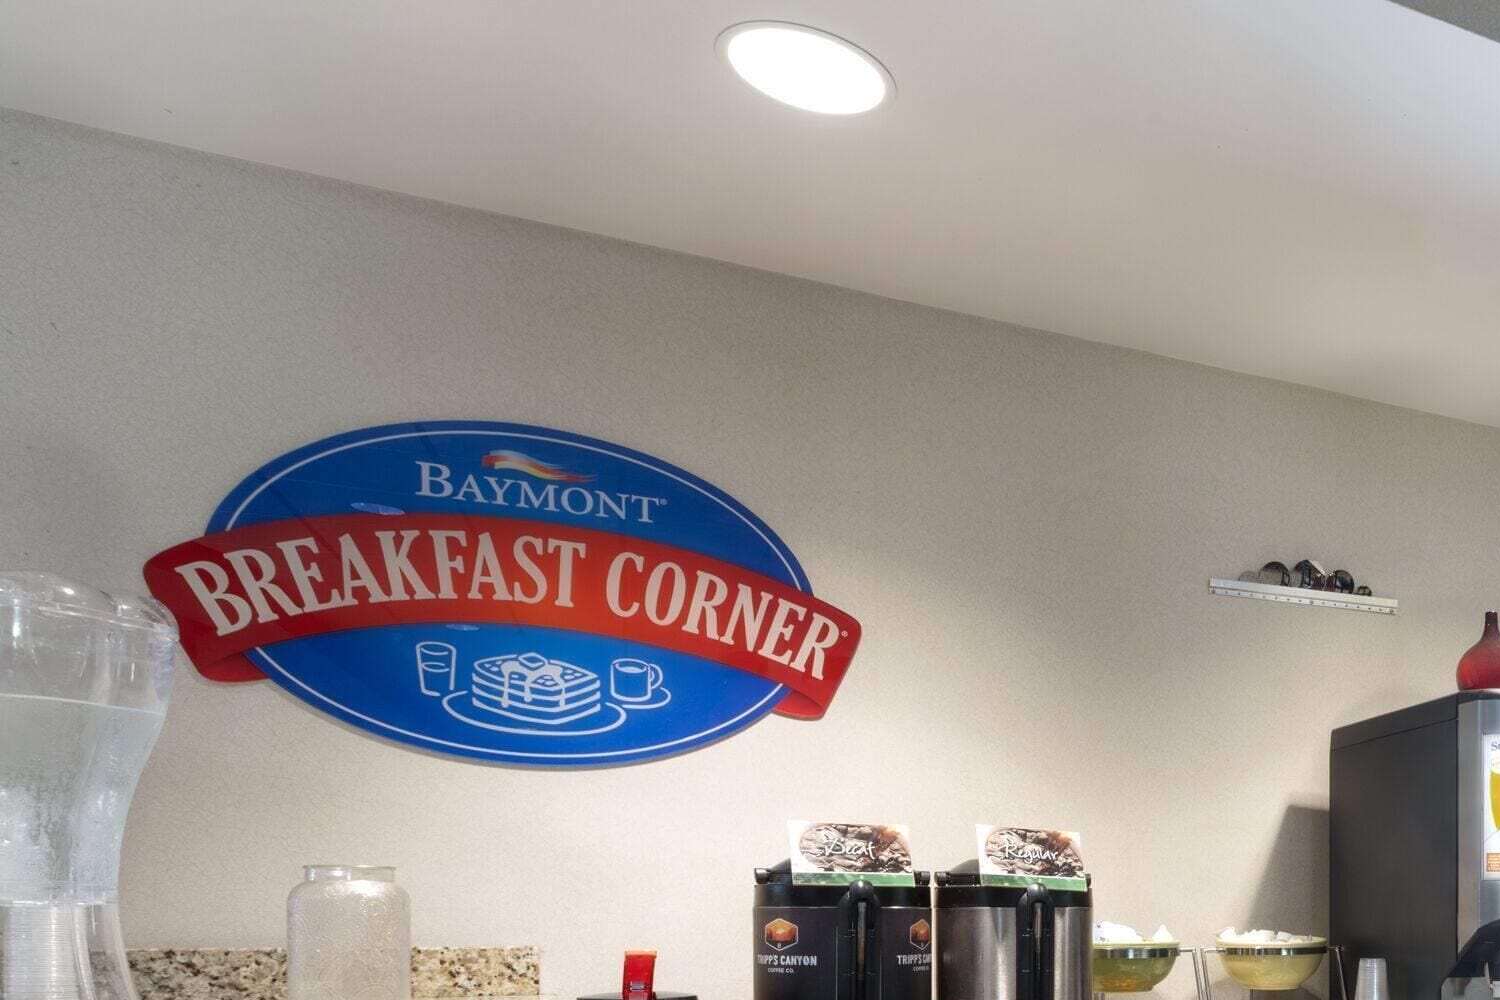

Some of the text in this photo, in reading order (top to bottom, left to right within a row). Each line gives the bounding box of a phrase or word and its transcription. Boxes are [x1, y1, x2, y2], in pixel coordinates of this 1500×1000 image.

[415, 461, 660, 524] BAYMONT
[174, 529, 839, 681] BREAKFAST CORNER
[823, 833, 876, 860] Decaf
[1000, 843, 1058, 864] Regular
[780, 955, 817, 966] CANYON
